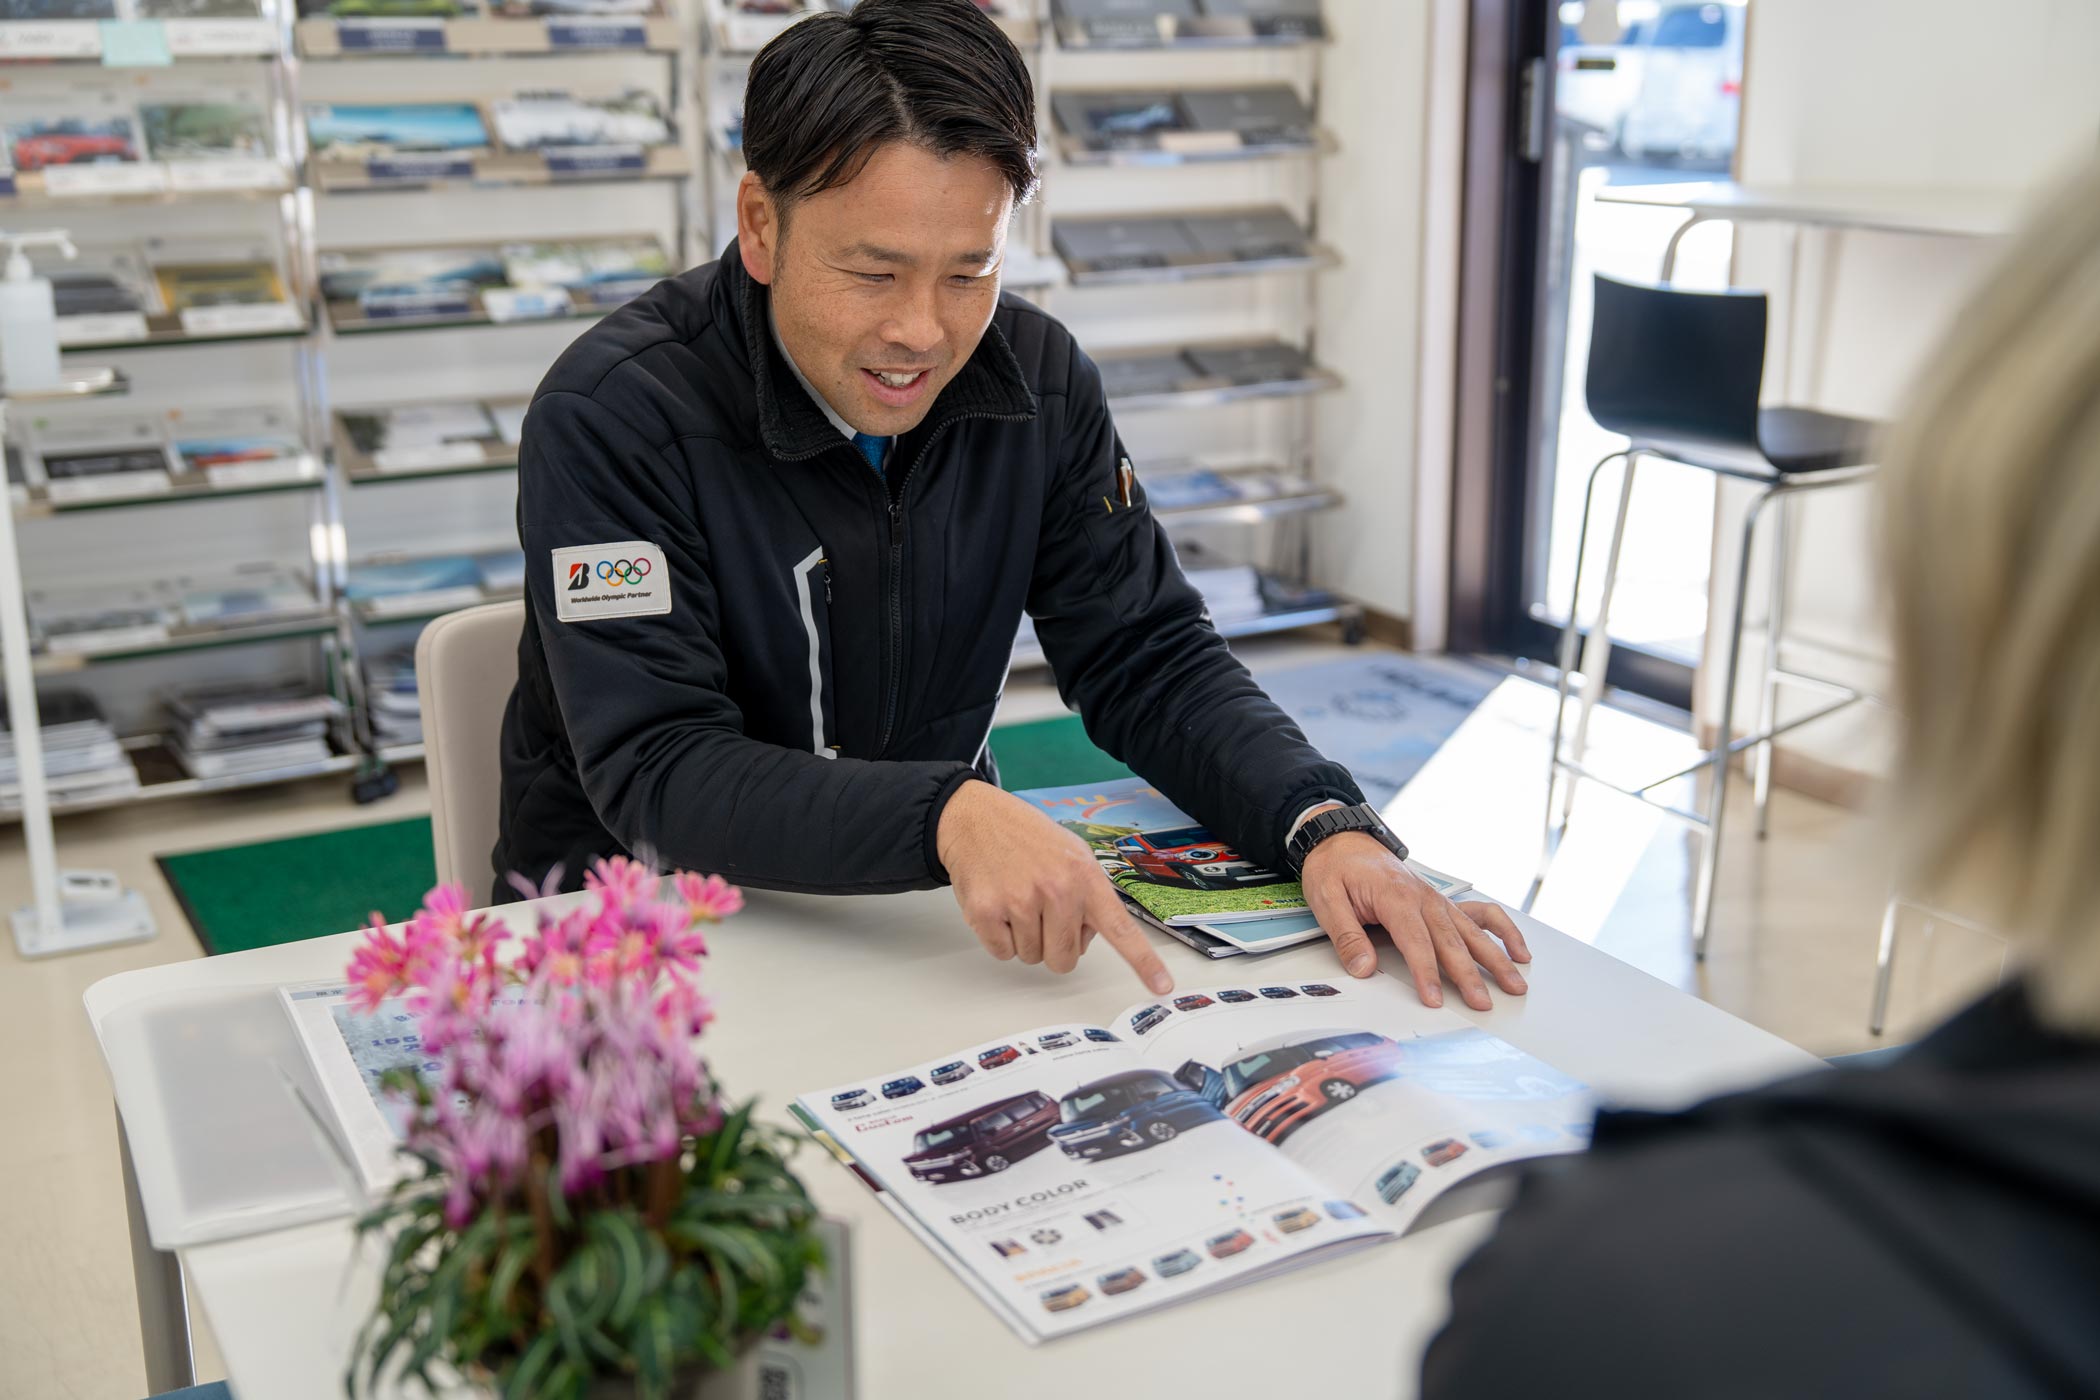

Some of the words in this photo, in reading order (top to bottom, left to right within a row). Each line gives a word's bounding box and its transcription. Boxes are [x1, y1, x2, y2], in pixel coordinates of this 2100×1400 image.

[571, 595, 600, 604] Worldwide
[601, 592, 626, 602] Olympic
[627, 591, 652, 599] Partner
[950, 1202, 1011, 1225] BODY
[1015, 1178, 1090, 1207] COLOR
